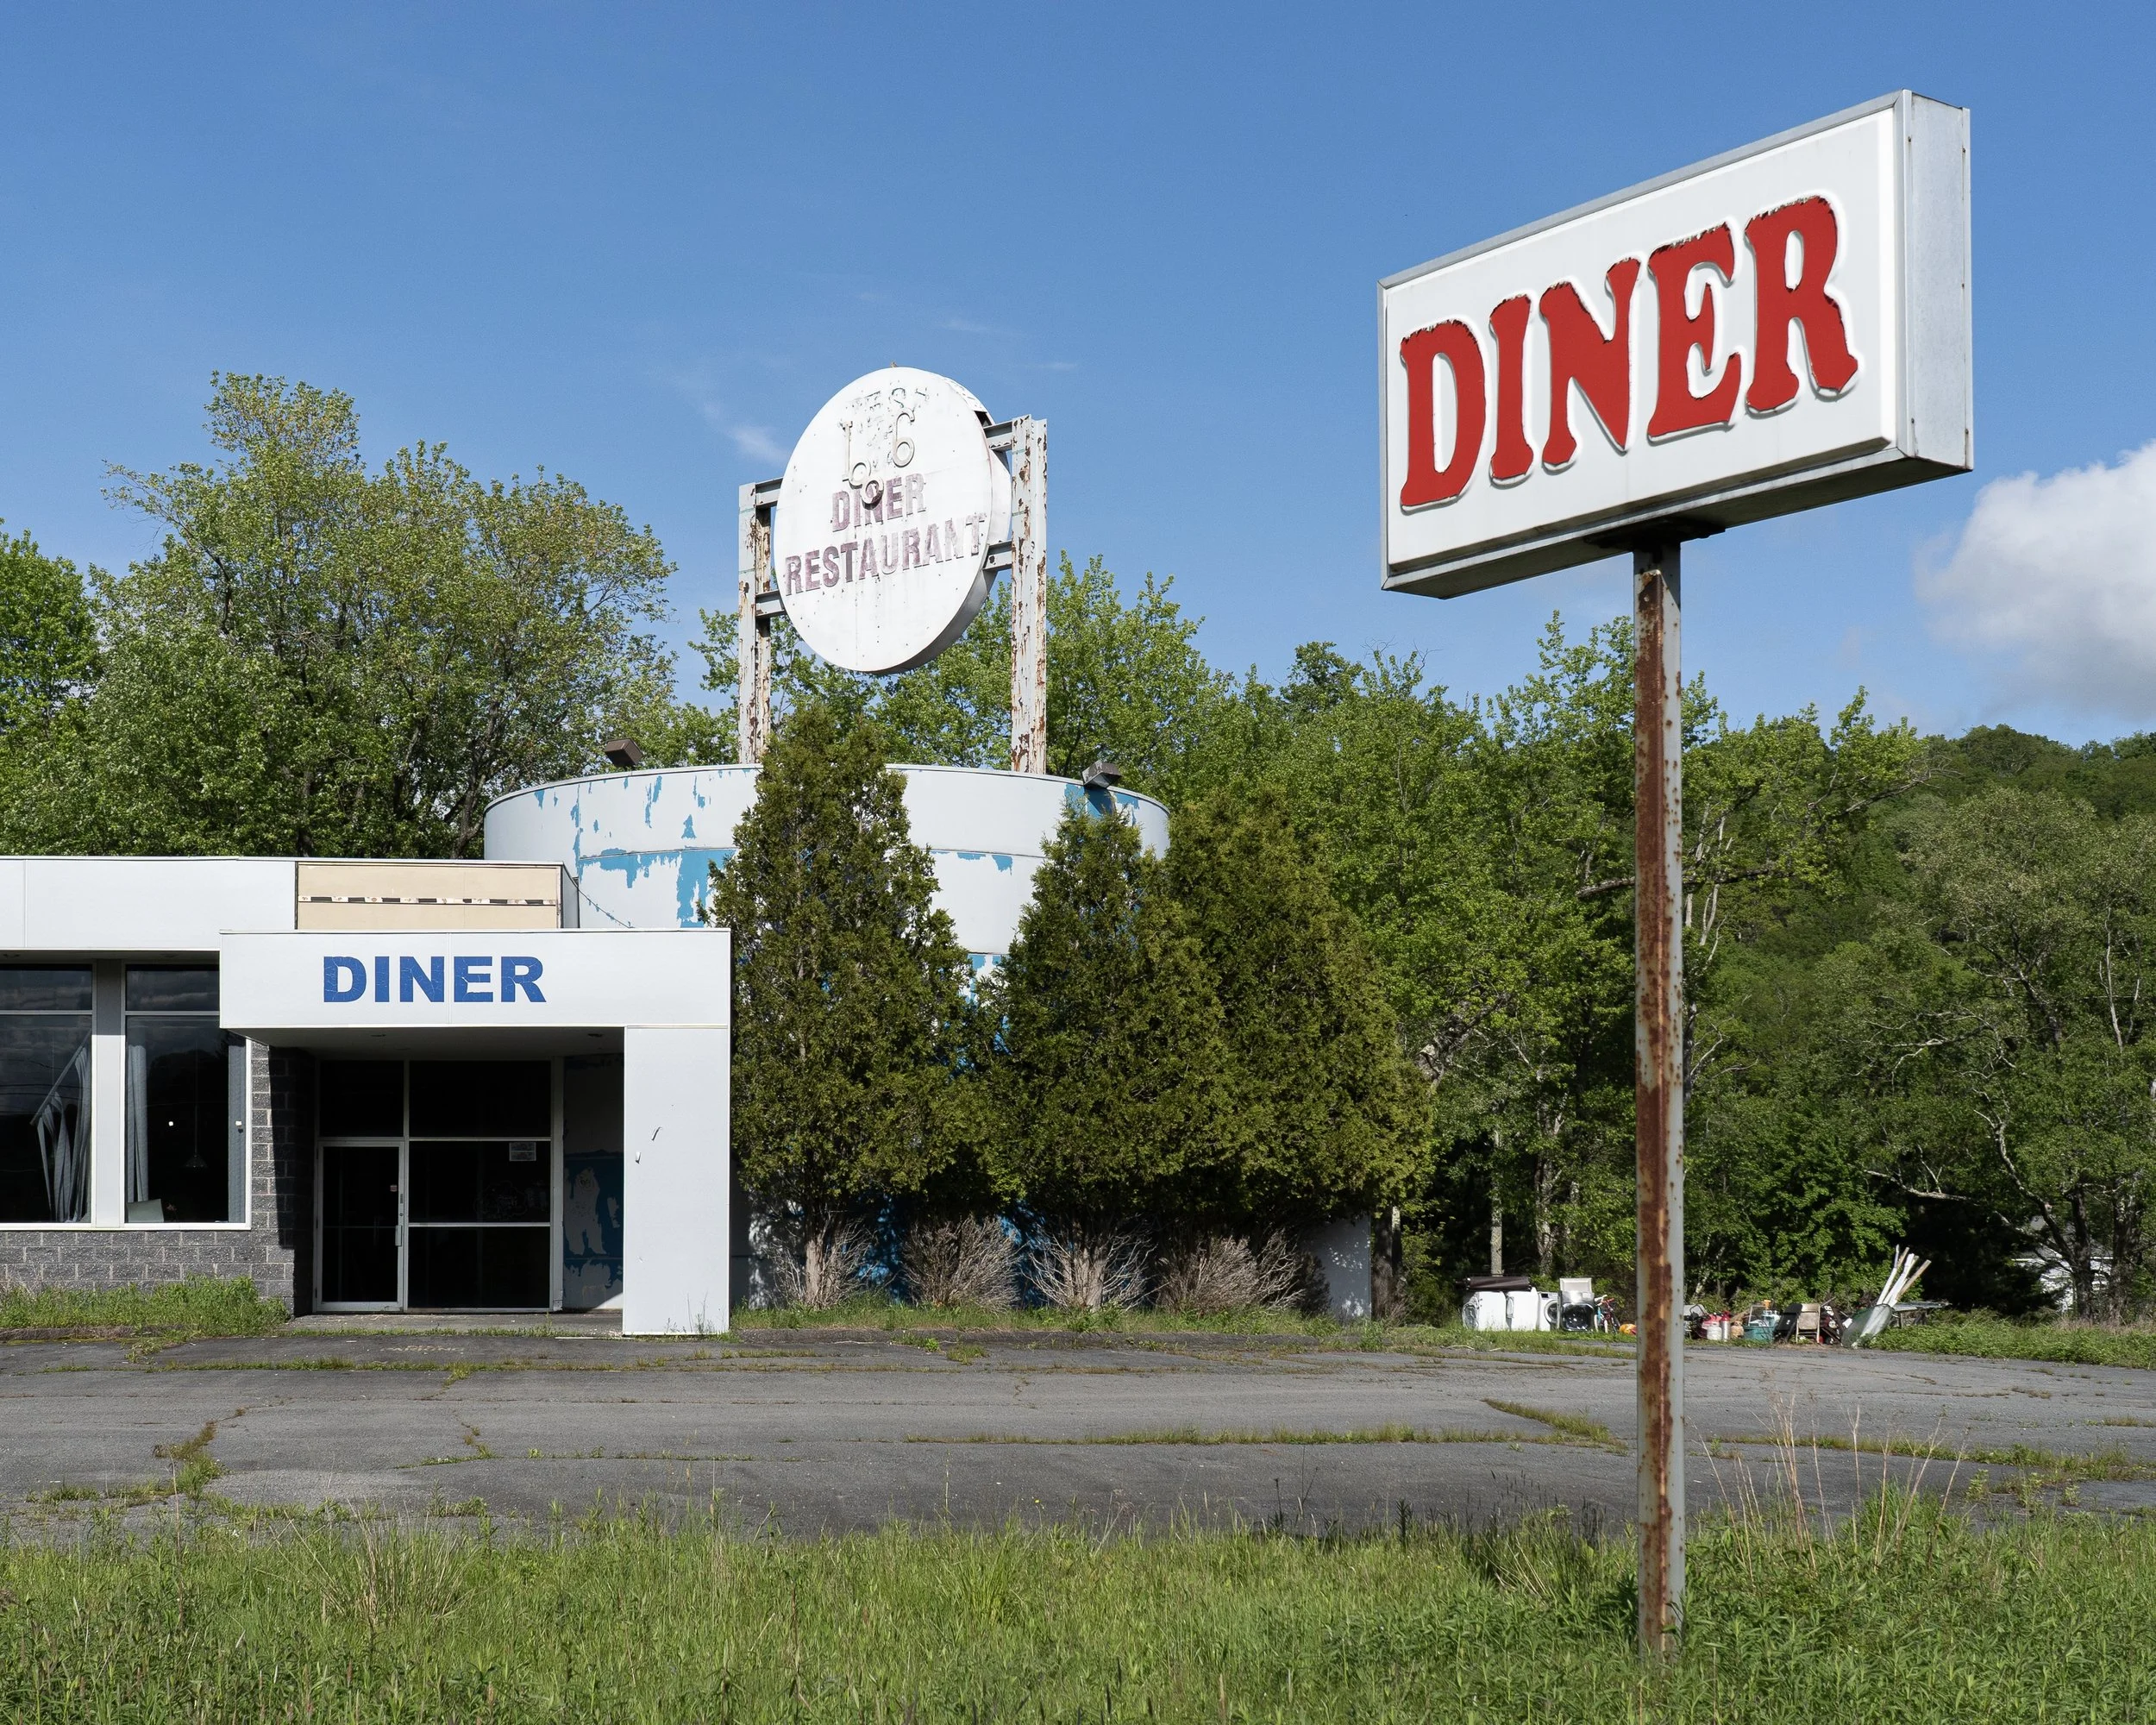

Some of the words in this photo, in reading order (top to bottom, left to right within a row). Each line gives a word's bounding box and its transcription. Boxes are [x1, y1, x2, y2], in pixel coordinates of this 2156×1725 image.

[1400, 195, 1858, 511] DINER
[831, 473, 926, 532] DINER
[785, 512, 987, 597] RESTAURANT
[323, 956, 547, 1003] DINER
